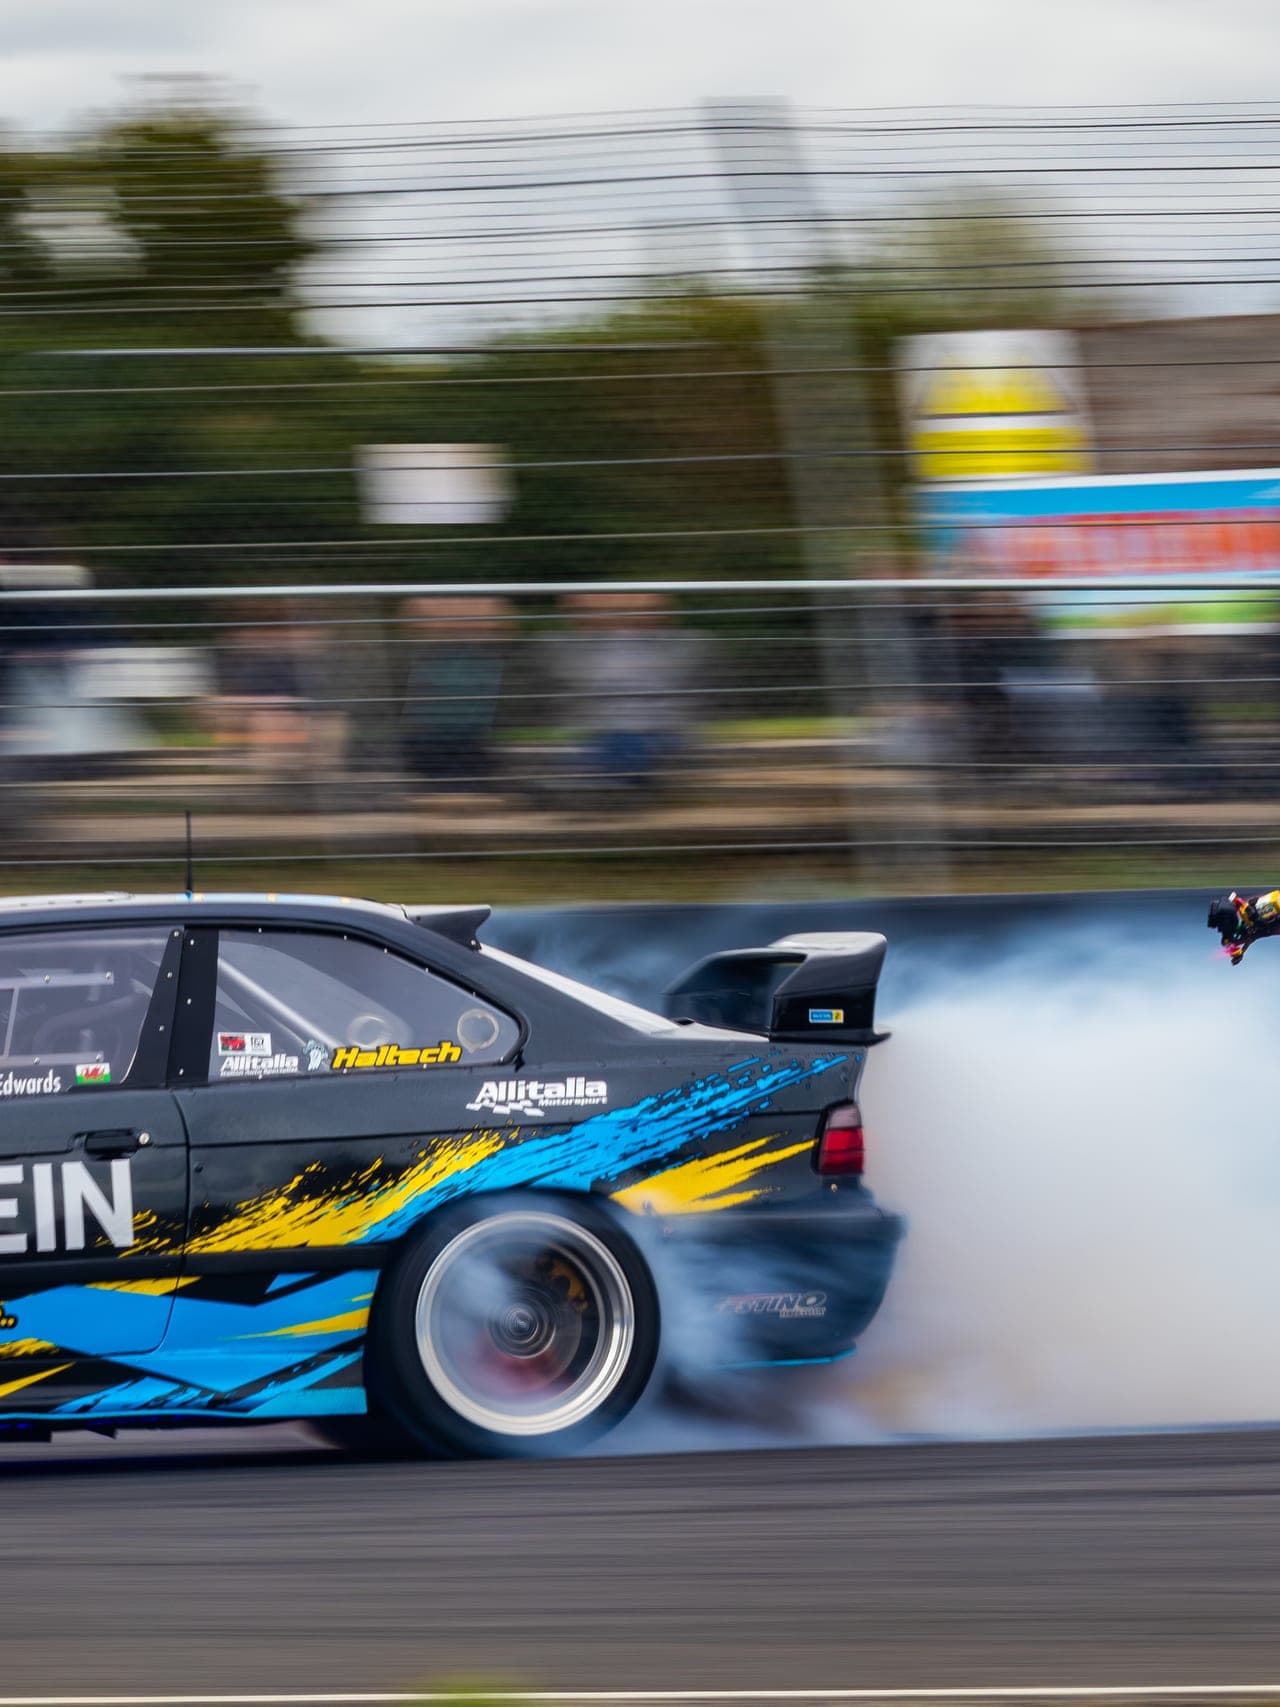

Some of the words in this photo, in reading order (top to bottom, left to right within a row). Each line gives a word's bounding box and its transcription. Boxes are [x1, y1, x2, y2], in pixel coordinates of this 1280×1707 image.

[331, 1040, 463, 1070] Haltech
[475, 1076, 608, 1104] Allitalia
[538, 1096, 608, 1107] Motorsport
